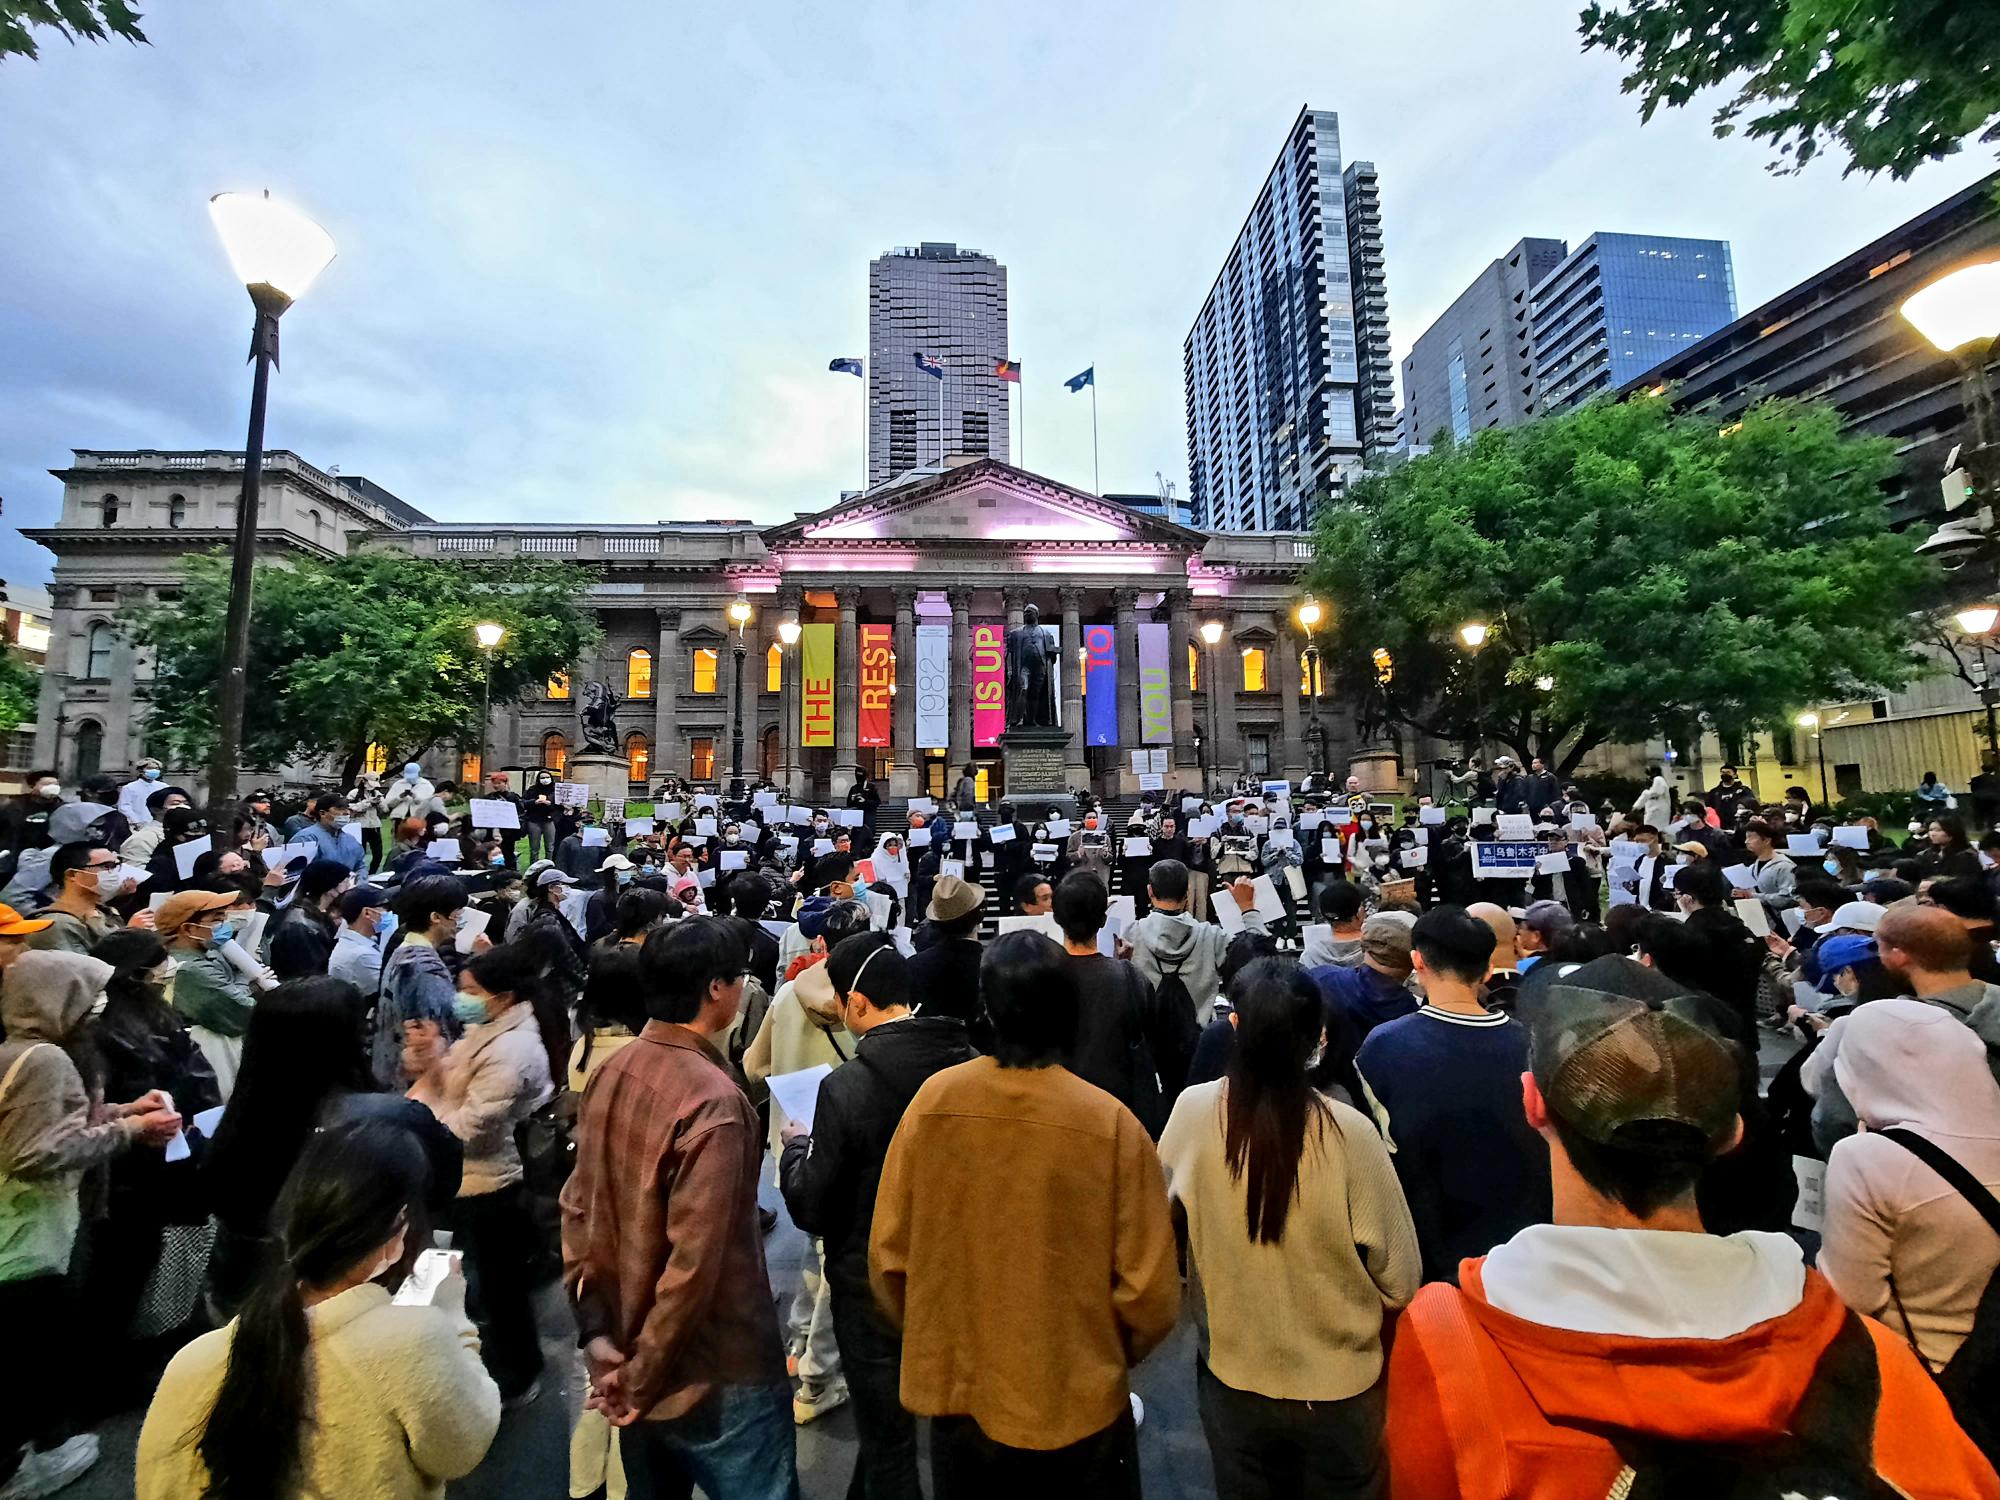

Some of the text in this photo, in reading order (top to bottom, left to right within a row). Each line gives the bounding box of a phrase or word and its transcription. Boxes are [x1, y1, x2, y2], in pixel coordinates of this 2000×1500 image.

[862, 627, 890, 710] REST
[975, 627, 1002, 673] UP
[1087, 626, 1113, 672] TO
[805, 678, 831, 743] THE
[975, 681, 1002, 710] IS
[1143, 668, 1169, 739] YOU
